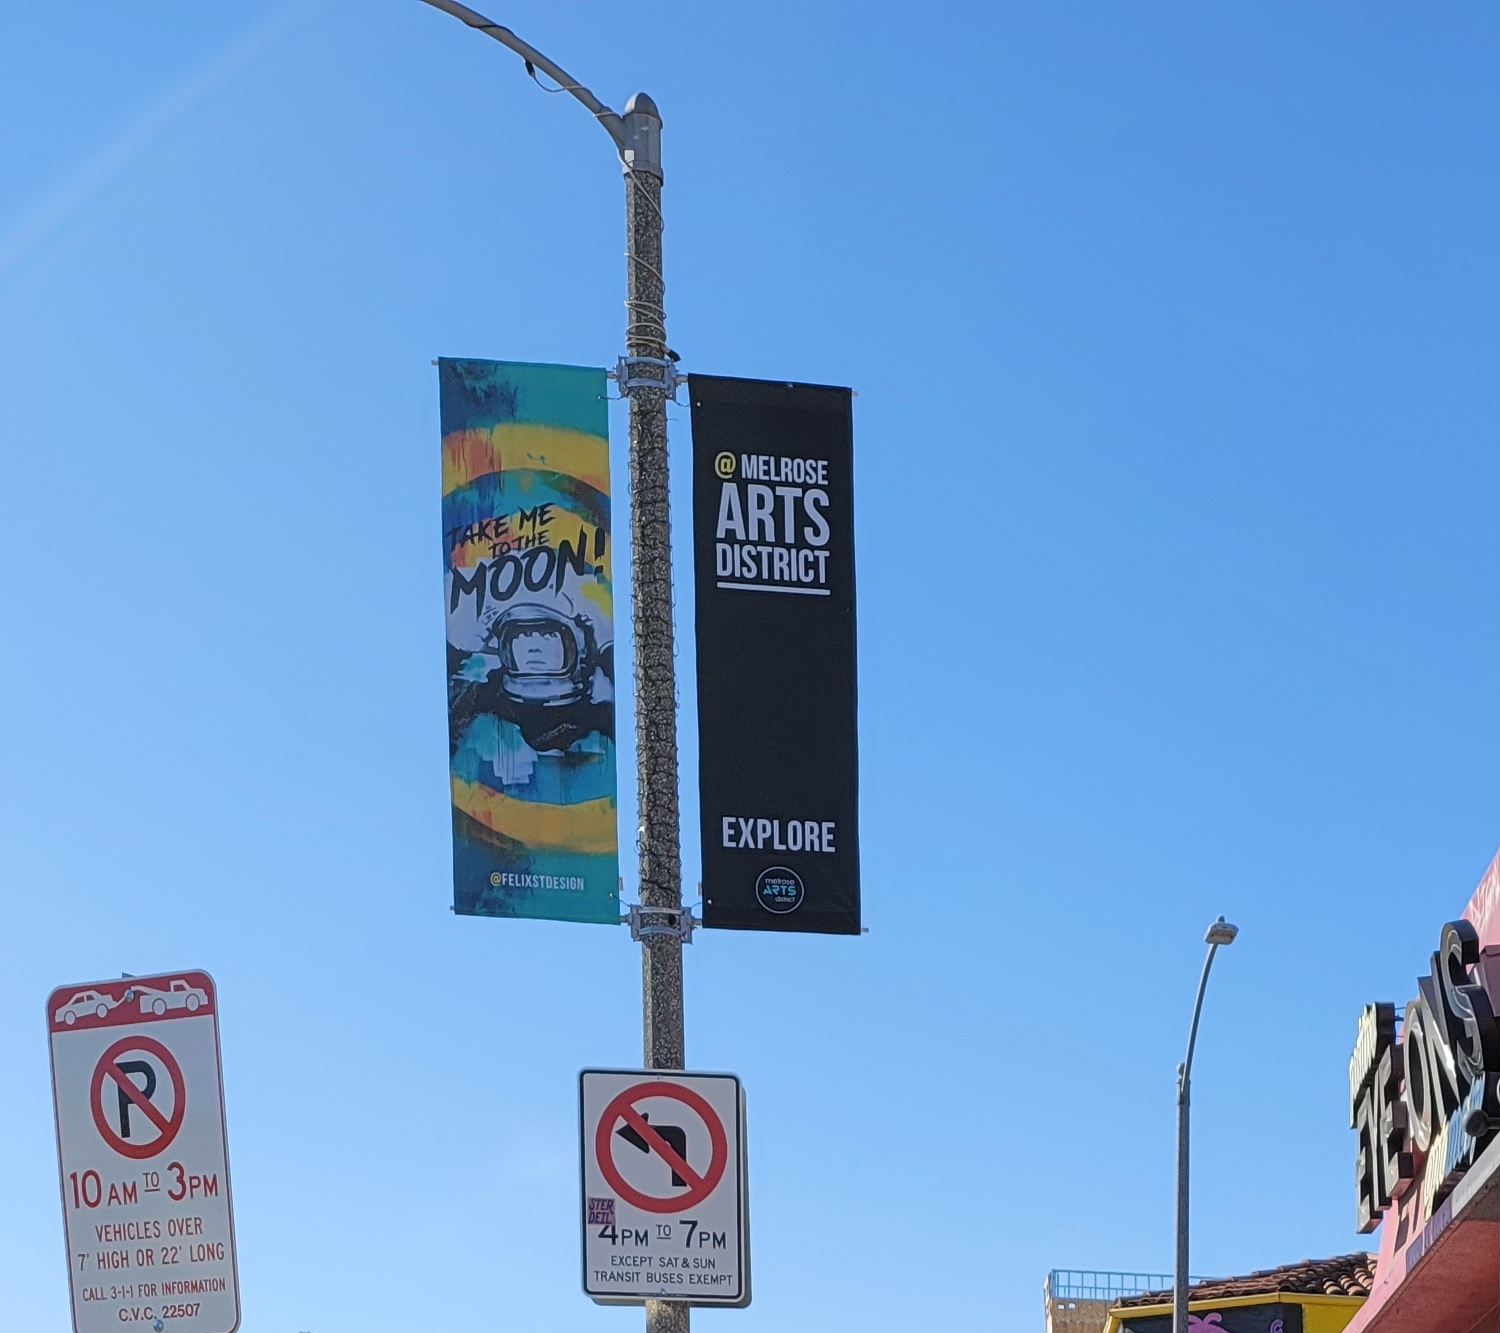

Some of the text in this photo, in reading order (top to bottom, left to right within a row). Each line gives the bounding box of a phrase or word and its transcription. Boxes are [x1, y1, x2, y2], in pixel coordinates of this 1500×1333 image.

[741, 454, 829, 486] MELROSE
[446, 502, 556, 550] TAKE ME
[716, 482, 831, 547] ARTS
[488, 529, 550, 559] TO THE
[449, 524, 605, 622] MOON!
[717, 543, 830, 584] DISTRICT
[722, 816, 836, 852] EXPLORE
[490, 871, 585, 891] @FELIXSTDESIGN
[142, 1171, 160, 1188] TO
[95, 1217, 203, 1243] VEHICLES OVER
[656, 1224, 671, 1237] TO
[97, 1250, 130, 1270] HIGH
[136, 1248, 155, 1266] OR
[161, 1245, 182, 1265] 22'
[190, 1242, 225, 1263] LONG
[611, 1255, 653, 1267] EXCEPT
[659, 1257, 680, 1268] SAT
[693, 1258, 716, 1269] SUN
[82, 1277, 226, 1302] CALL 3-1-1 FOR INFORMATION
[594, 1270, 733, 1285] TRANSIT BUSES EXEMPT
[118, 1303, 201, 1322] C.V.C. 22507
